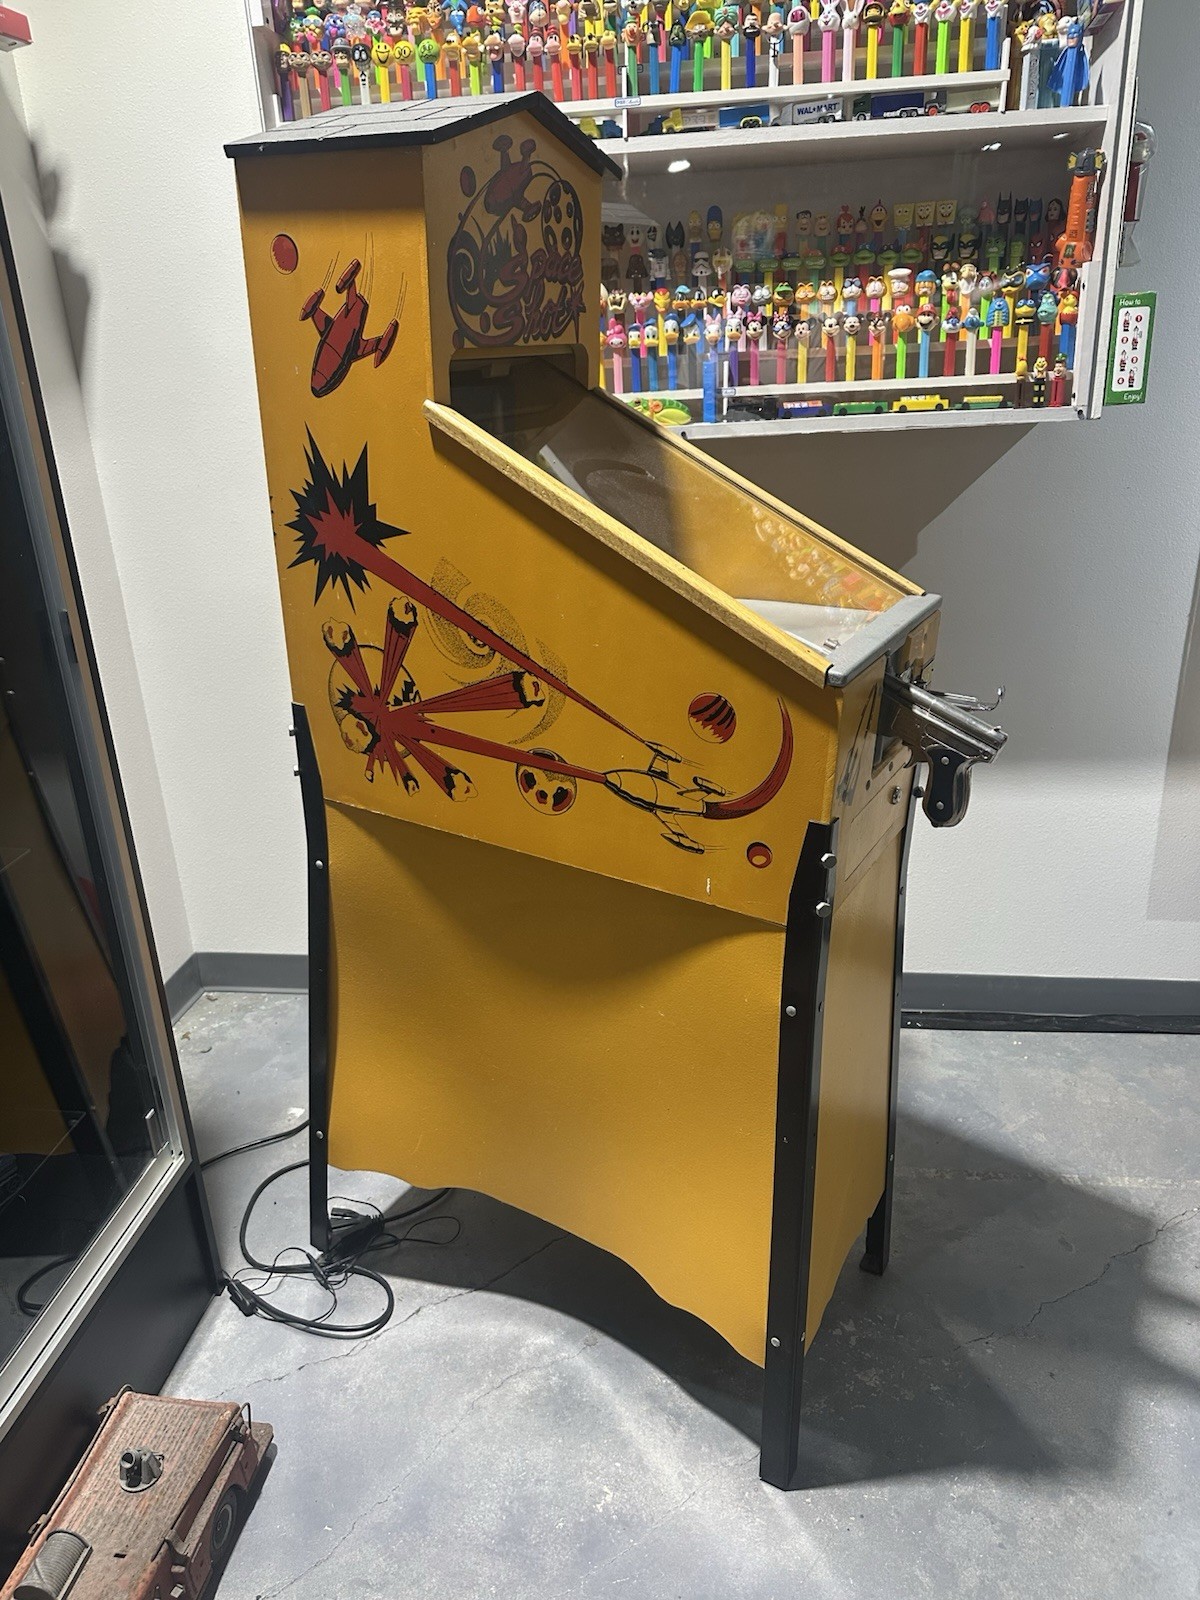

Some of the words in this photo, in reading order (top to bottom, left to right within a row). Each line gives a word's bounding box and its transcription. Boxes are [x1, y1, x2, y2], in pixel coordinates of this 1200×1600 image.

[486, 246, 584, 306] Space
[489, 278, 578, 346] Shot
[1119, 298, 1134, 306] How
[1123, 392, 1143, 402] Enjoy!
